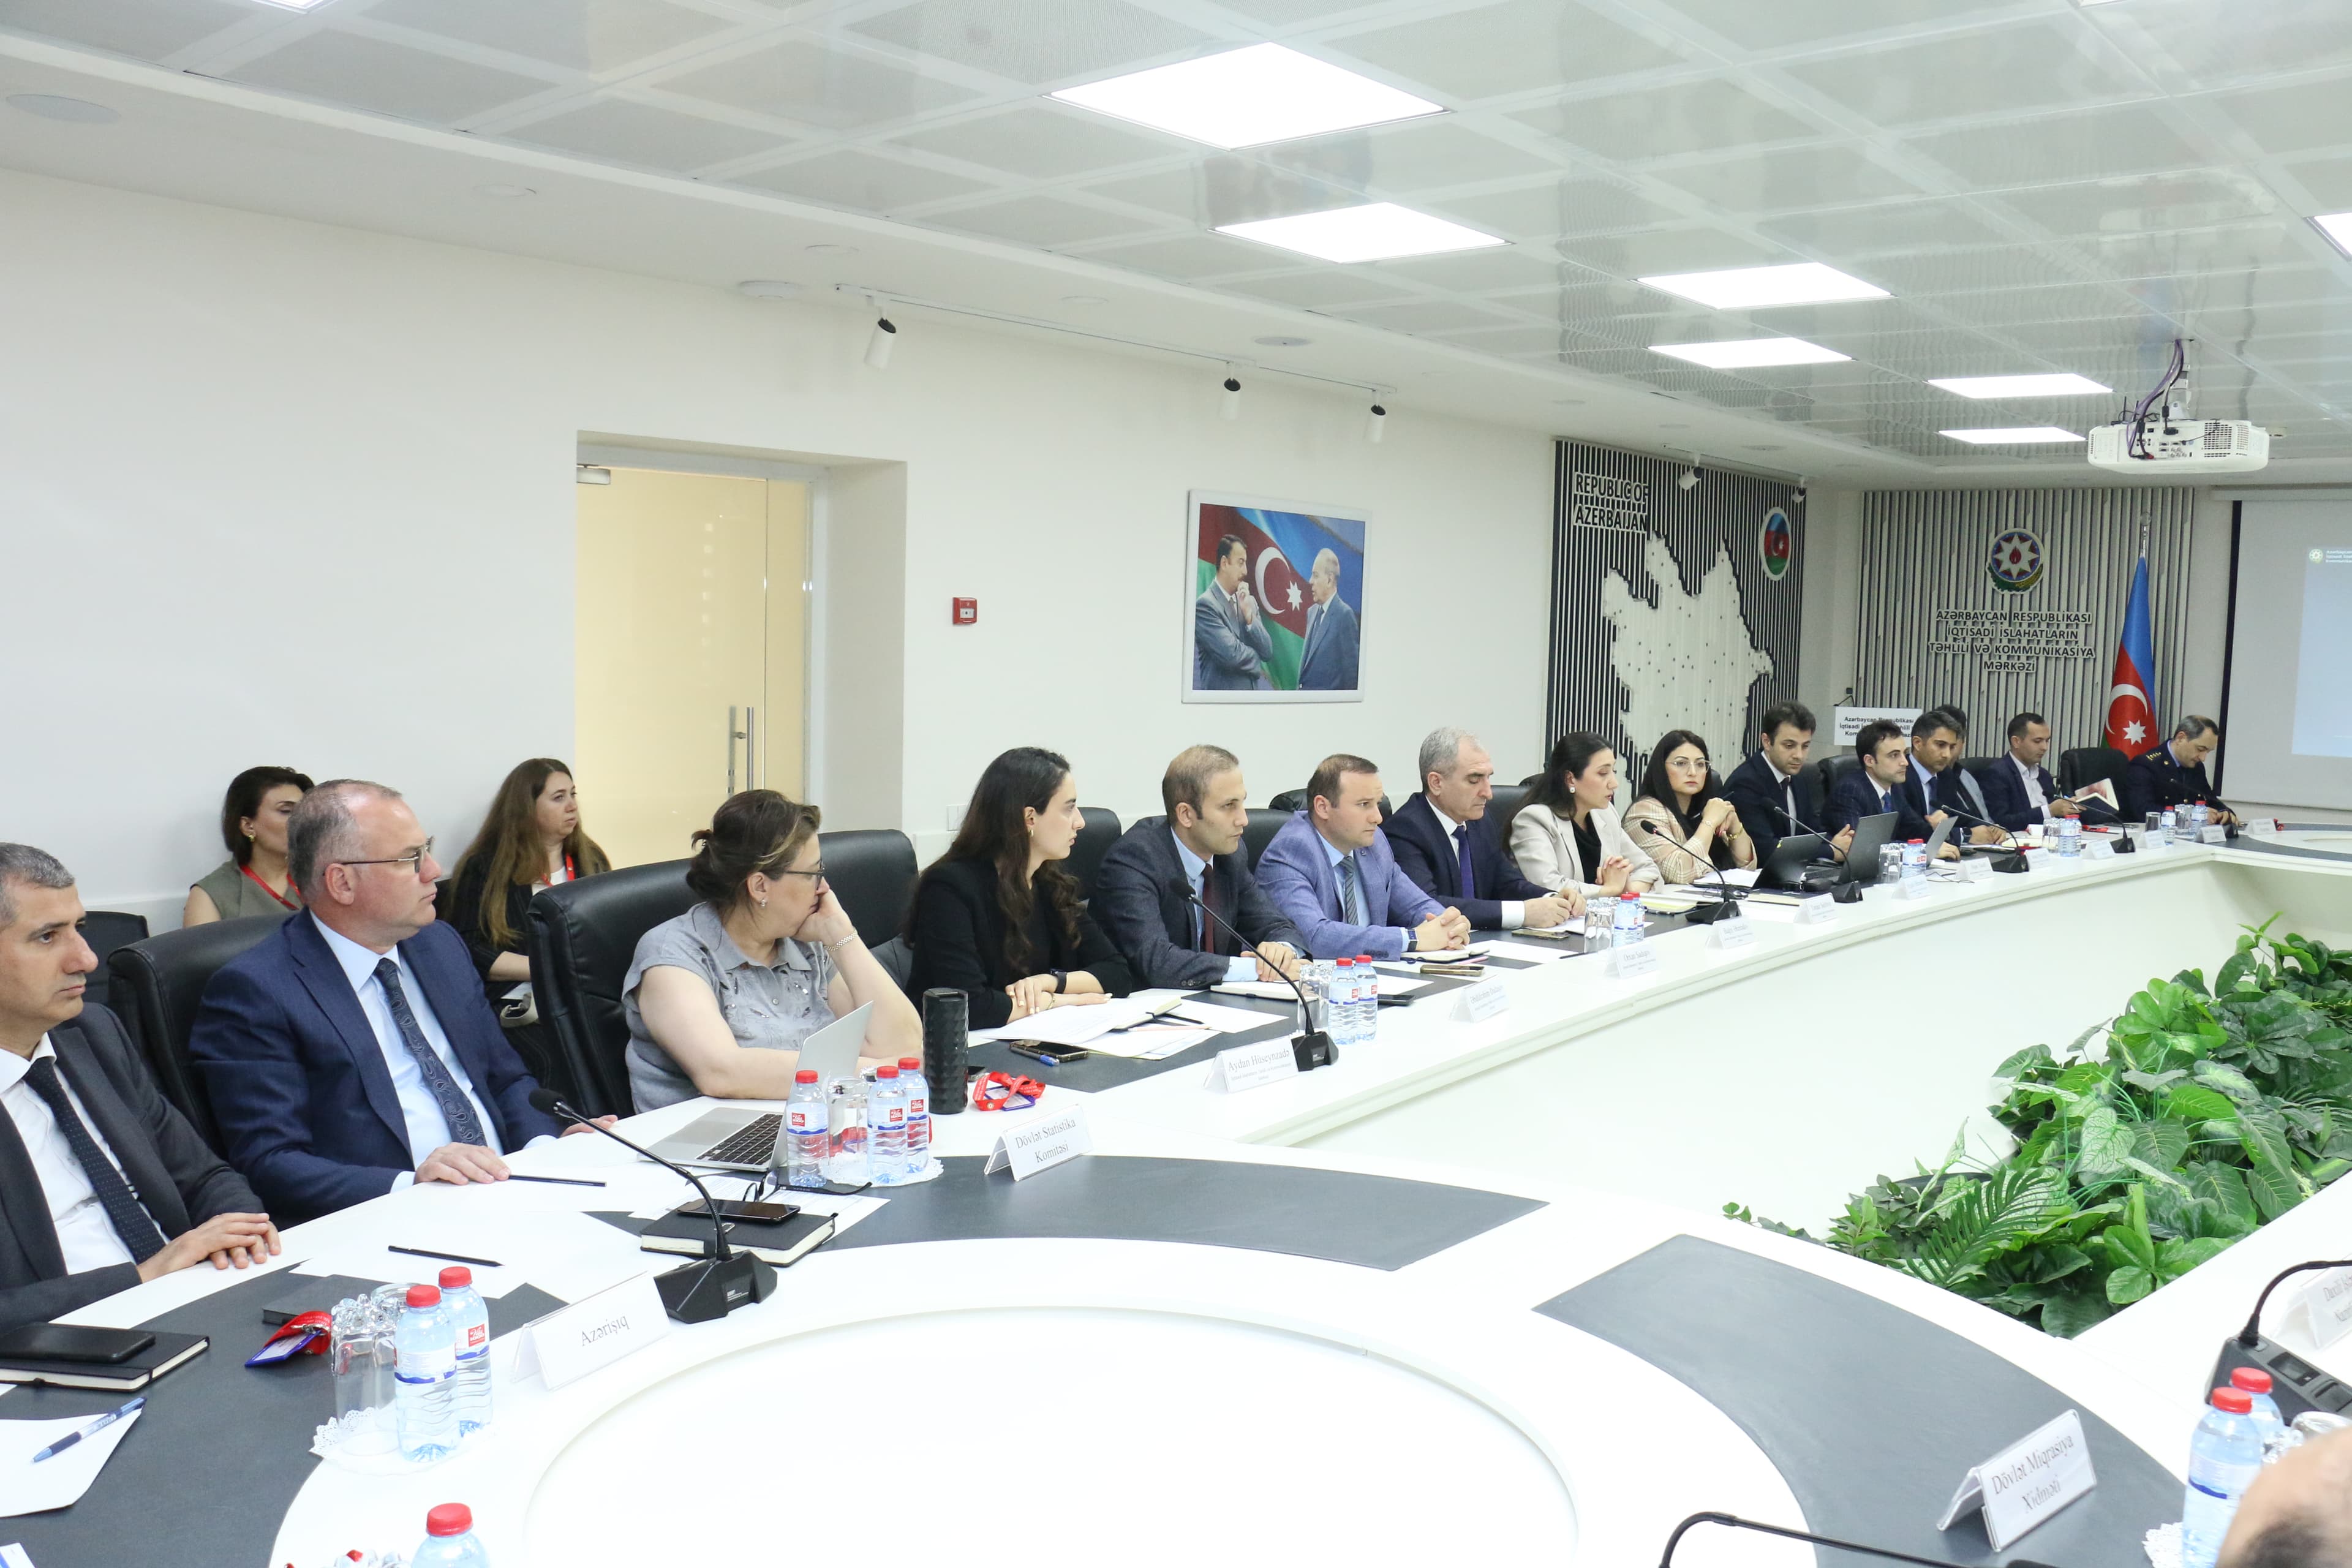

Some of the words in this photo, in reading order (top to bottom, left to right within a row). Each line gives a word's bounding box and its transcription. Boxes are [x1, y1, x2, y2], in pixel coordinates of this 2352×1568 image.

[1576, 473, 1630, 500] REPUBLIC
[1634, 484, 1648, 502] OF
[1575, 505, 1647, 531] AZERBAIJAN
[1936, 611, 2007, 621] AZƏRBAYCAN
[2013, 611, 2091, 622] RESPUBLİKASI
[1948, 625, 1994, 637] İQTİSADİ
[2000, 626, 2078, 639] İSLAHATLARIN
[1930, 641, 1969, 653] TƏHLİLİ
[1975, 644, 1990, 653] VƏ
[1995, 643, 2094, 657] KOMMUNİKASİYA
[1984, 660, 2035, 672] MƏRKƏZİ
[1229, 1058, 1251, 1072] Aydan
[1251, 1048, 1290, 1066] Hüseynzadə
[1016, 1131, 1042, 1148] Dövlət
[1042, 1118, 1076, 1139] Statistika
[1035, 1141, 1069, 1163] Komitəsi
[582, 1316, 630, 1346] Azərişıq
[1991, 1464, 2028, 1495] Dövlət
[2026, 1436, 2074, 1472] Miqrasiya
[2022, 1475, 2062, 1513] Xidməti
